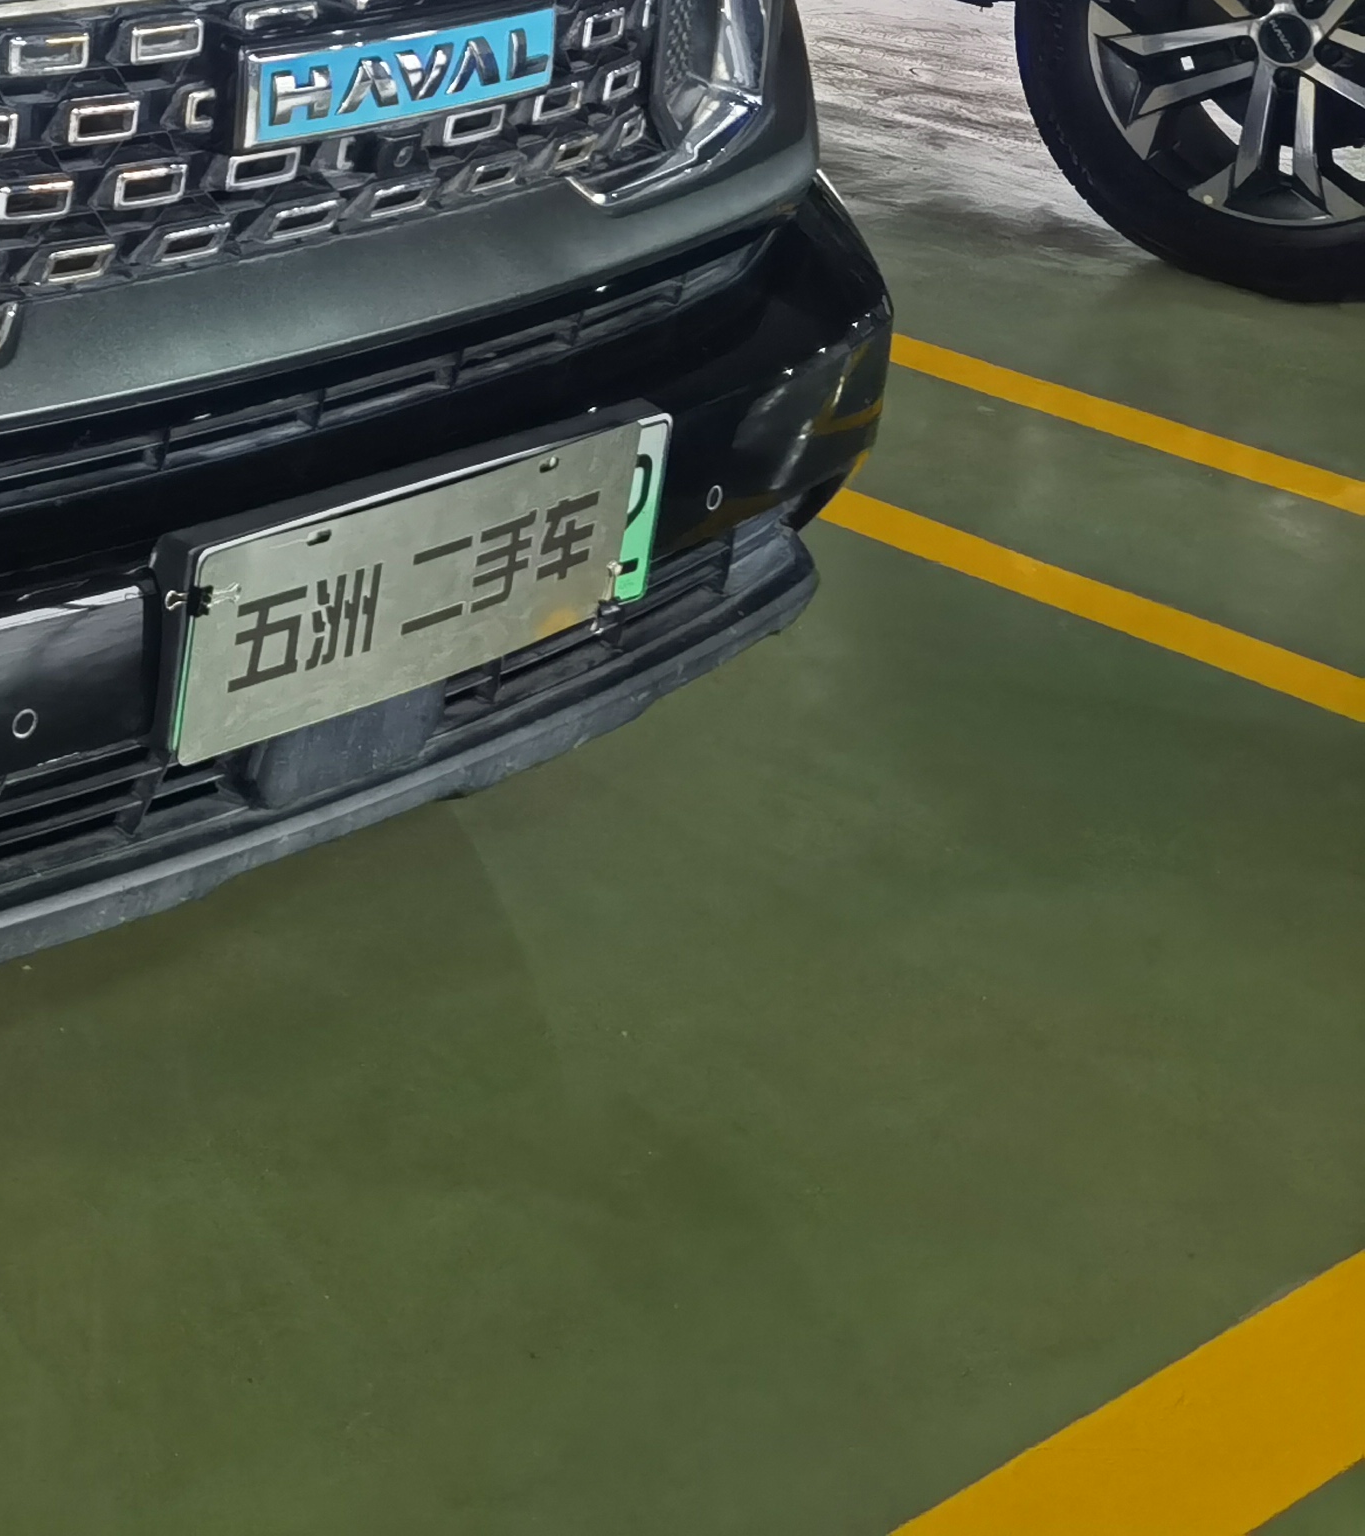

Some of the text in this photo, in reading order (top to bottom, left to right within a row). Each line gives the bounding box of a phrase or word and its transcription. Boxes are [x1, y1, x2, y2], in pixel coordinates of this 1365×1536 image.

[269, 28, 549, 126] HAVAL
[1269, 19, 1296, 59] HAVAL
[227, 562, 384, 693] 五洲
[401, 490, 601, 636] 二手车
